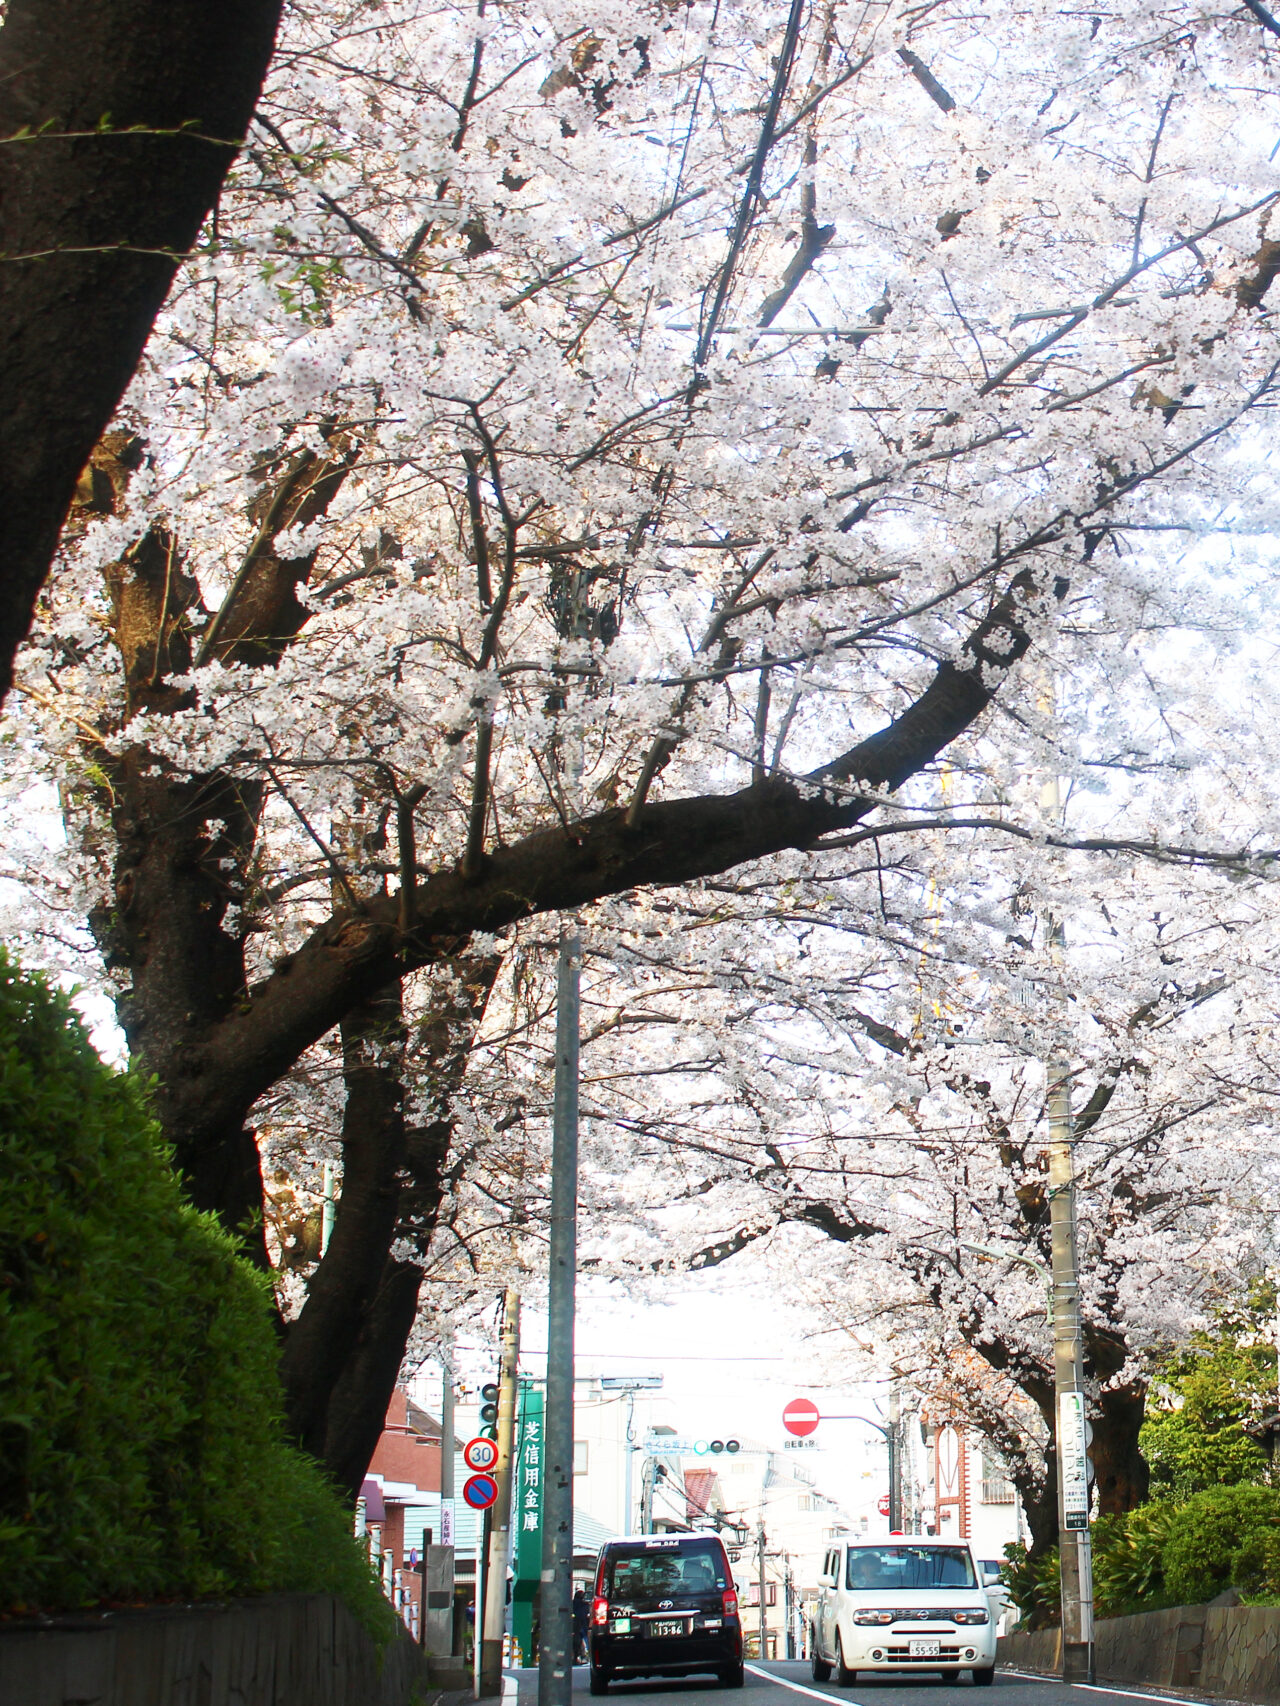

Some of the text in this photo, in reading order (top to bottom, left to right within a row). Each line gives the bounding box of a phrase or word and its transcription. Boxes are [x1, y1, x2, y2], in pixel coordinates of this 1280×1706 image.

[472, 1447, 491, 1463] 30
[523, 1421, 540, 1532] 芝信用金庫
[658, 1626, 681, 1636] 13-86
[915, 1646, 939, 1655] 55-55
